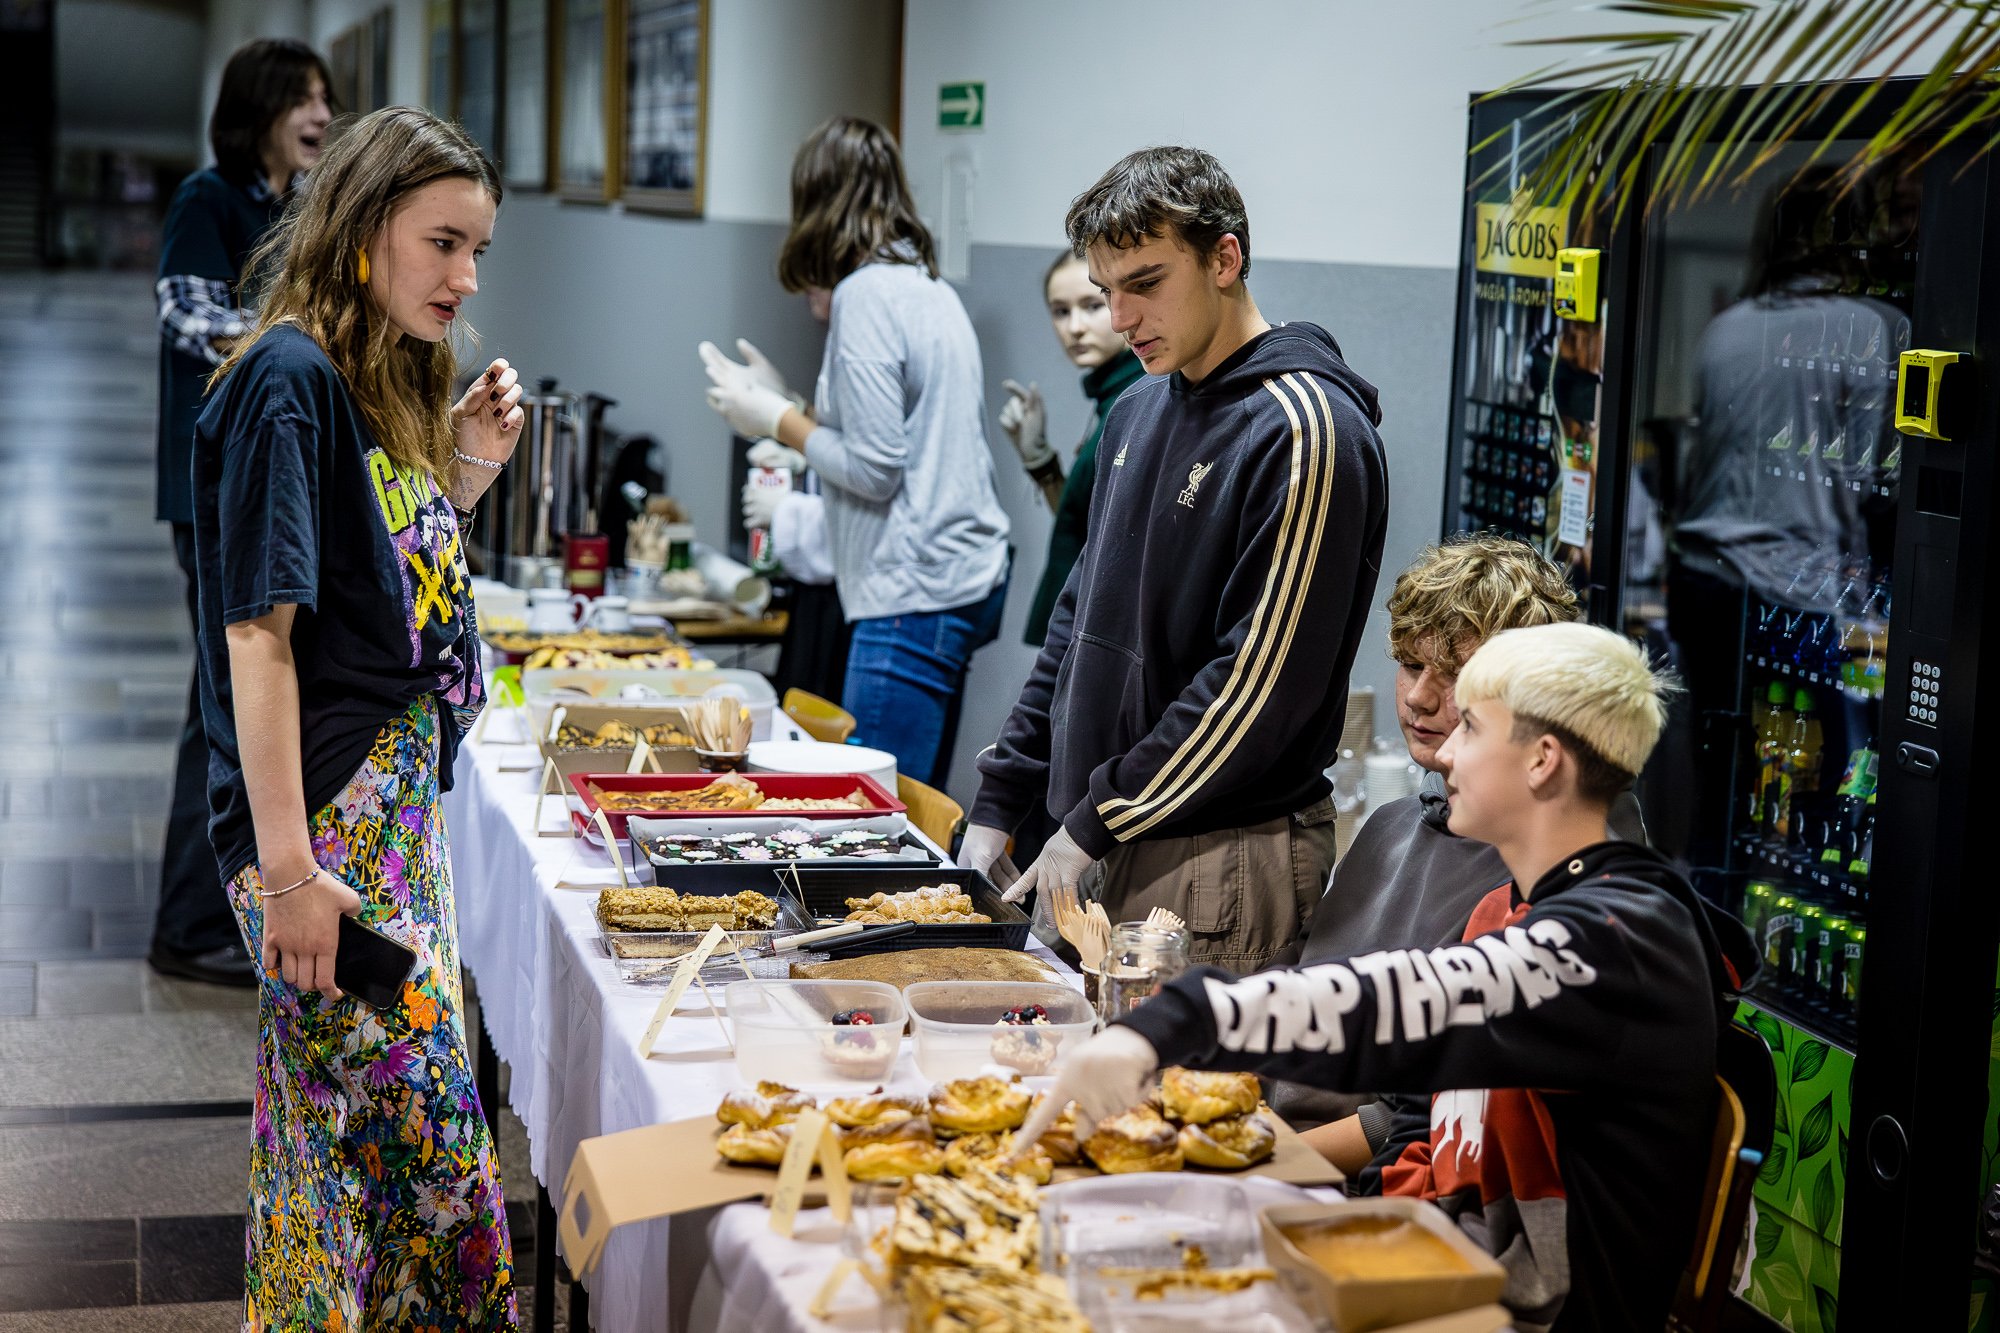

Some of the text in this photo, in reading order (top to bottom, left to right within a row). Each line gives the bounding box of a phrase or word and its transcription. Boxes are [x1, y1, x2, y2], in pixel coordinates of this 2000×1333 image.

[1480, 217, 1560, 261] JACOBS
[1510, 286, 1554, 307] AROMAT
[1177, 492, 1195, 509] LFC
